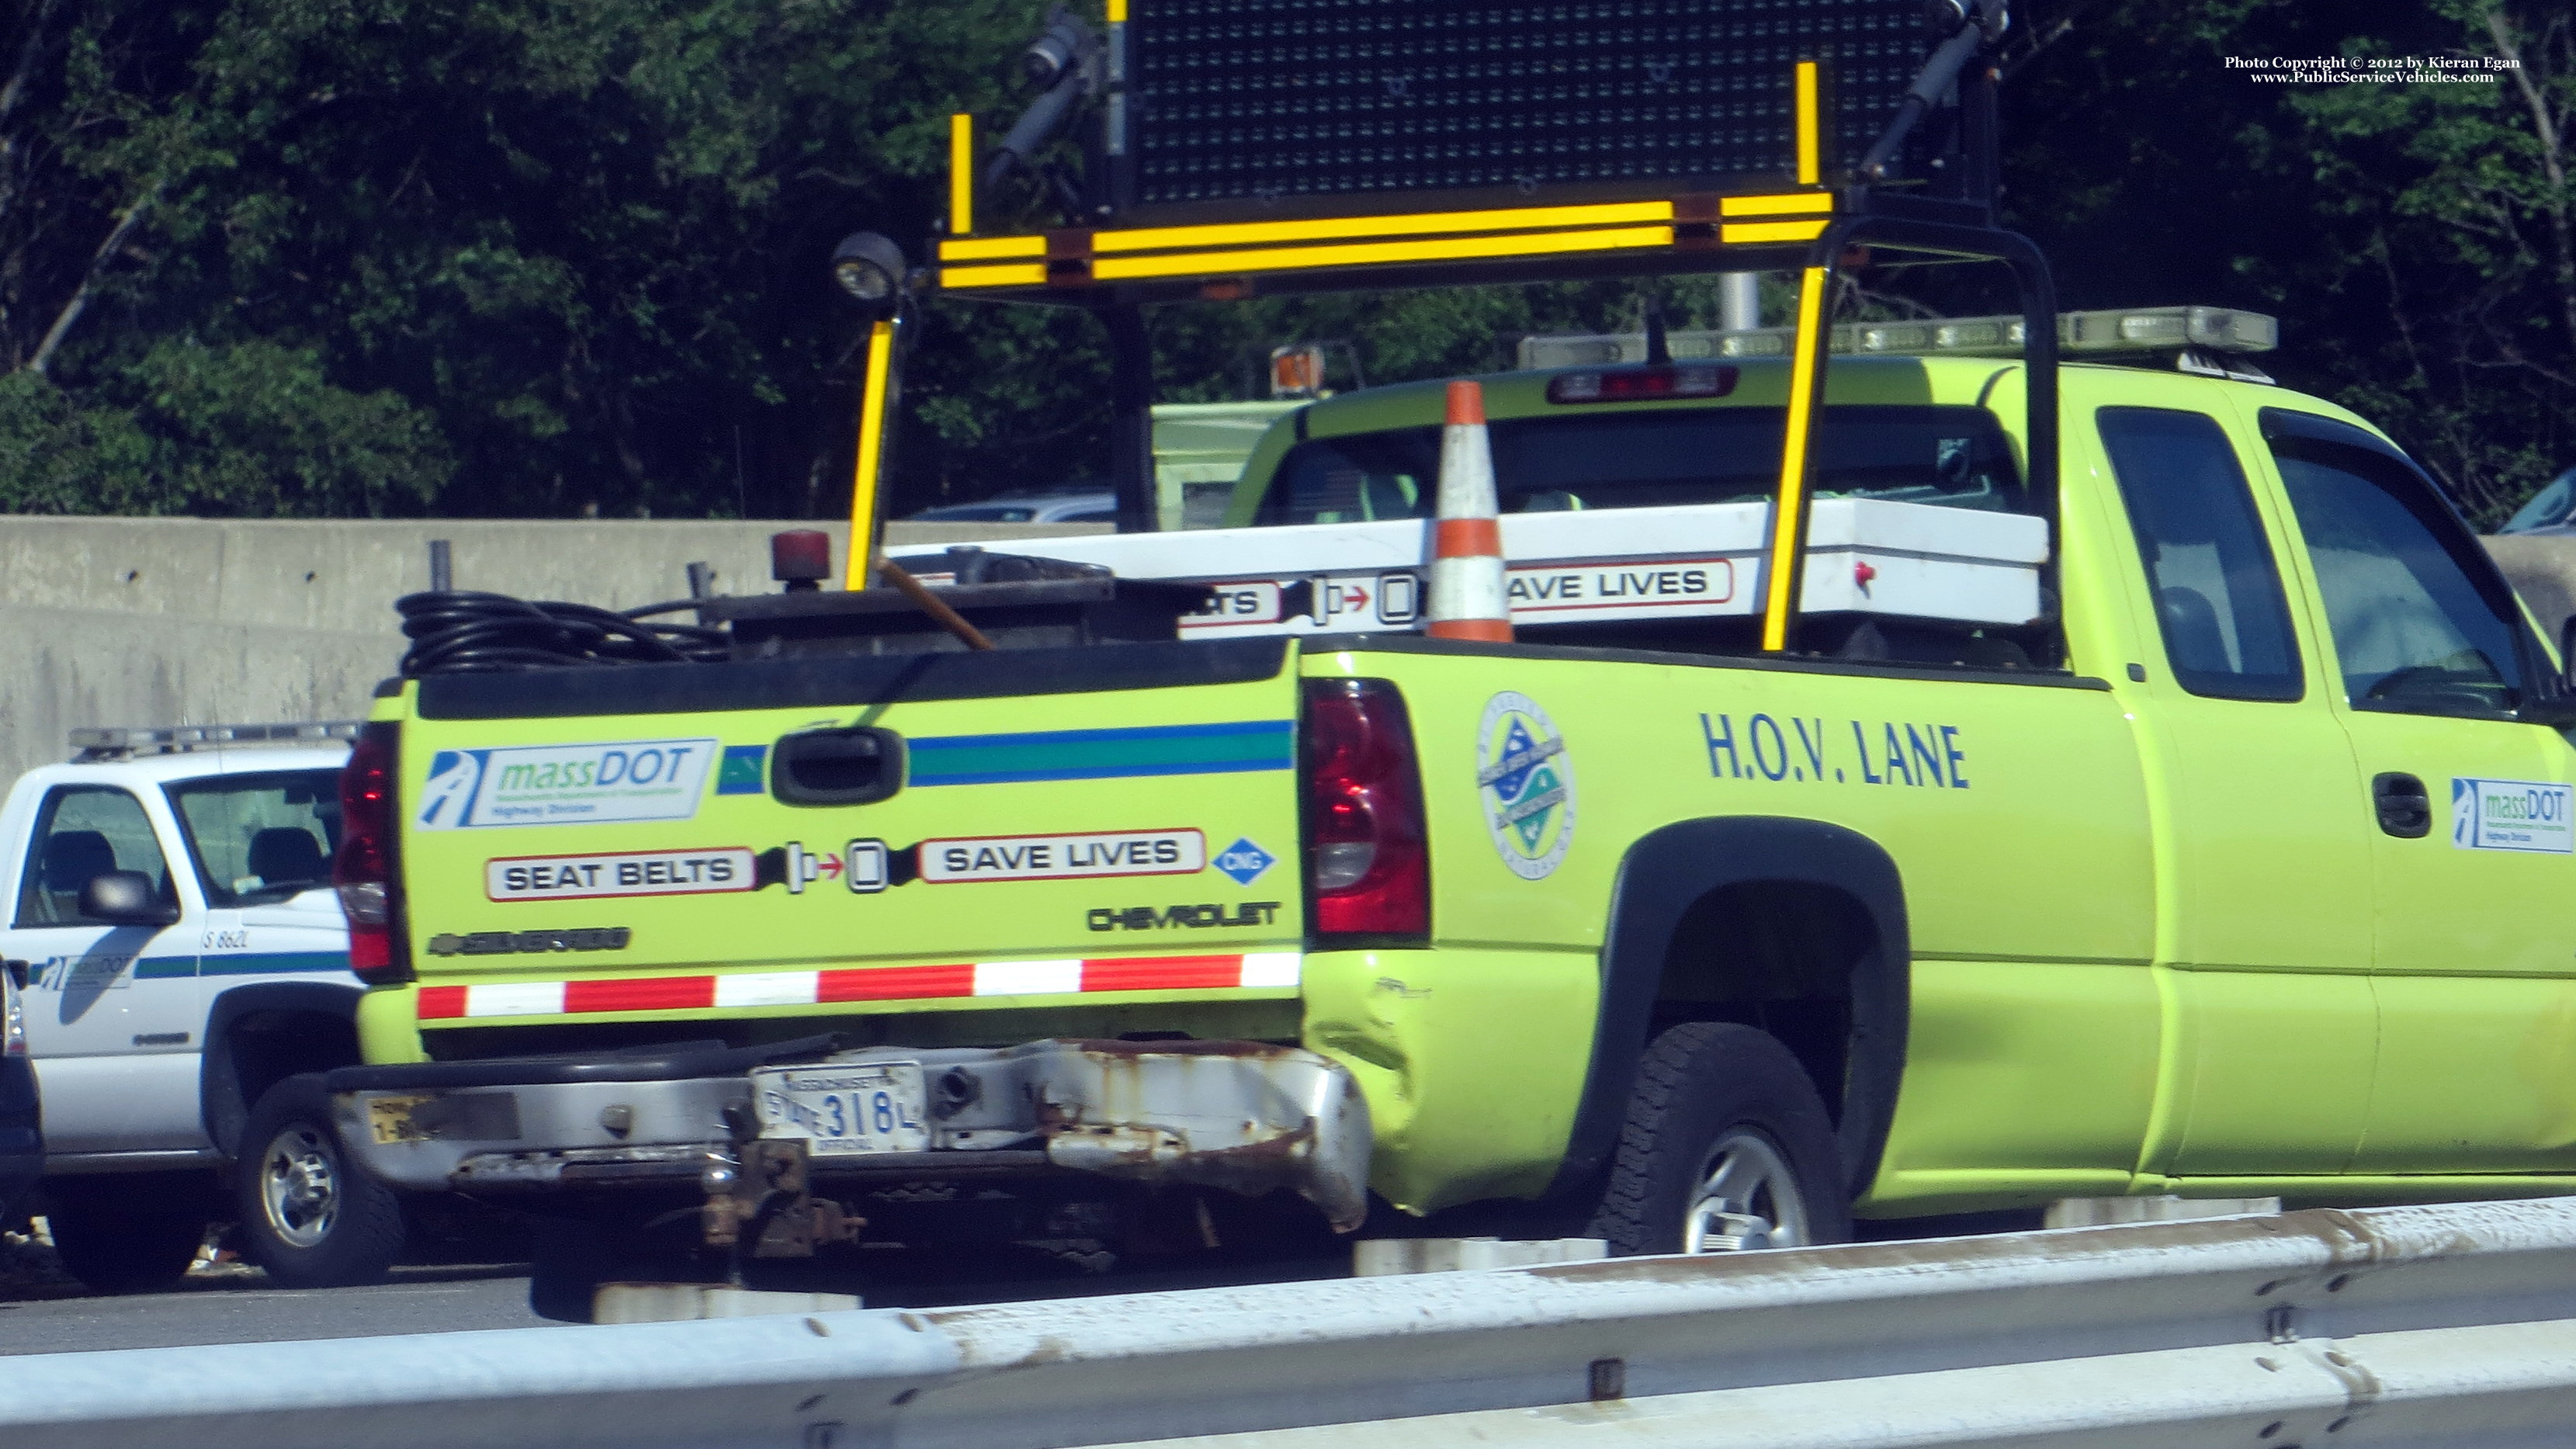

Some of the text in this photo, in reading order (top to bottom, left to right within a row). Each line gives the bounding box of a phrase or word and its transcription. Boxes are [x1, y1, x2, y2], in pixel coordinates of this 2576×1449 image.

[1508, 570, 1708, 600] AVE LIVES
[1699, 712, 1971, 789] H.O.V. LANE
[498, 747, 694, 791] massDOT
[2486, 789, 2565, 821] massDOT
[945, 839, 1179, 873] SAVE LIVES
[504, 858, 733, 892] SEAT BELTS
[1087, 901, 1282, 932] CHEVROLET
